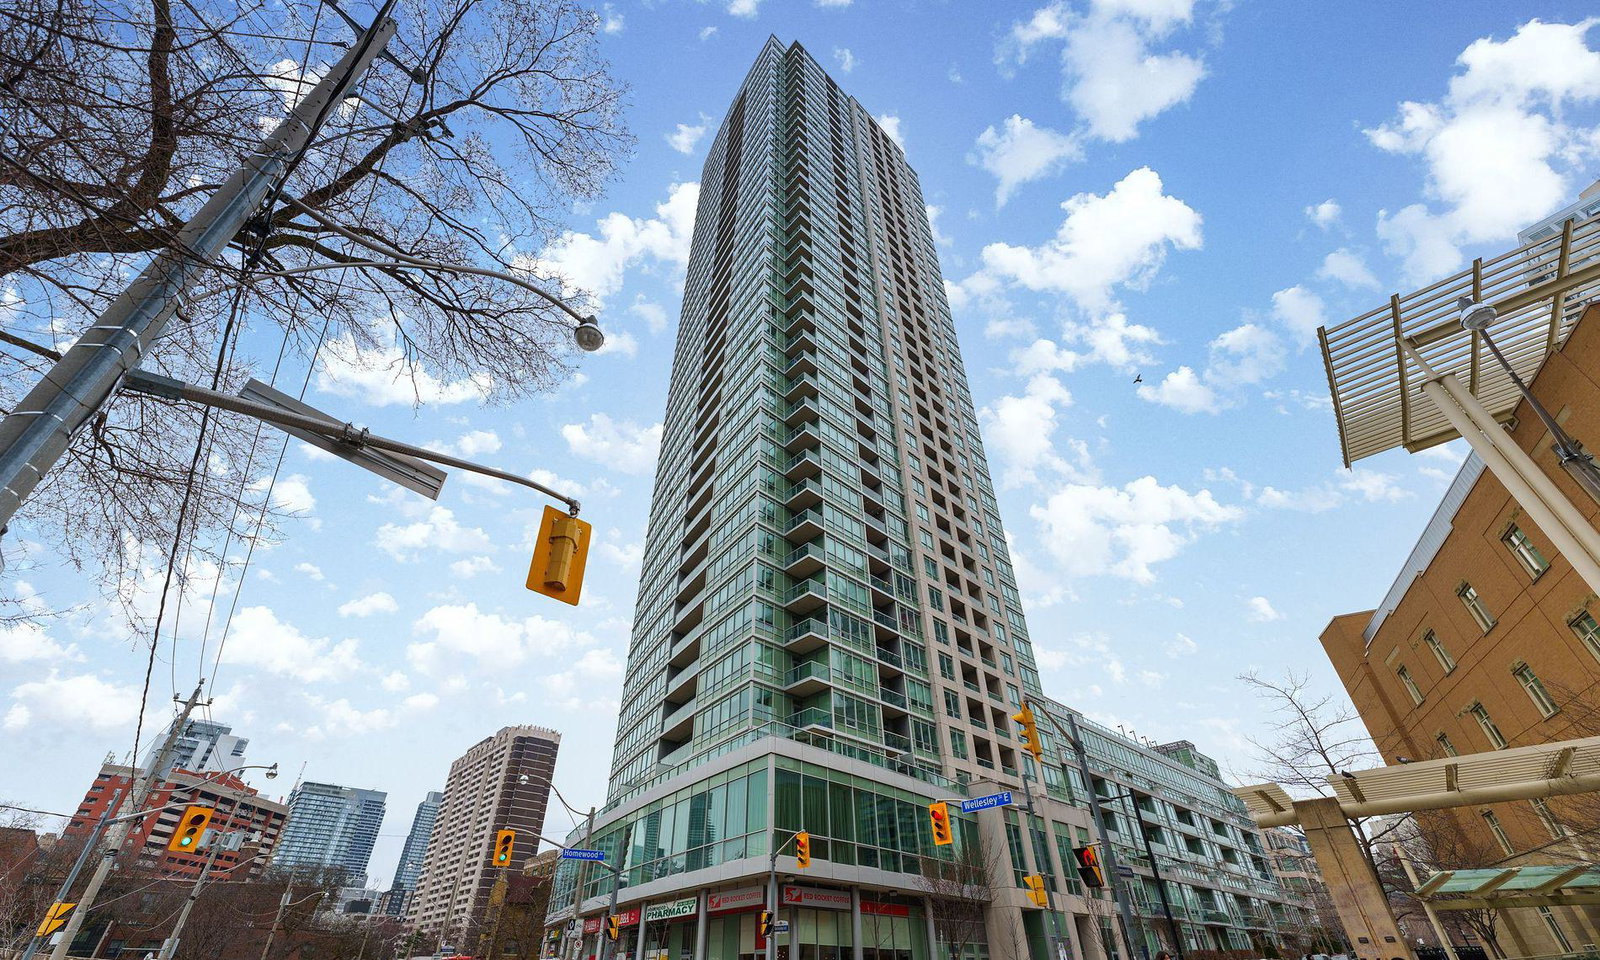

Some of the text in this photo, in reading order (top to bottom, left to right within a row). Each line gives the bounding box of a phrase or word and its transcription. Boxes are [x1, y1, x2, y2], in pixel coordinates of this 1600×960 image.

[964, 797, 998, 810] Wellesley
[1003, 793, 1009, 801] E
[564, 850, 599, 858] Homewood
[746, 891, 761, 900] COFFEE
[646, 905, 694, 919] PHARMACY
